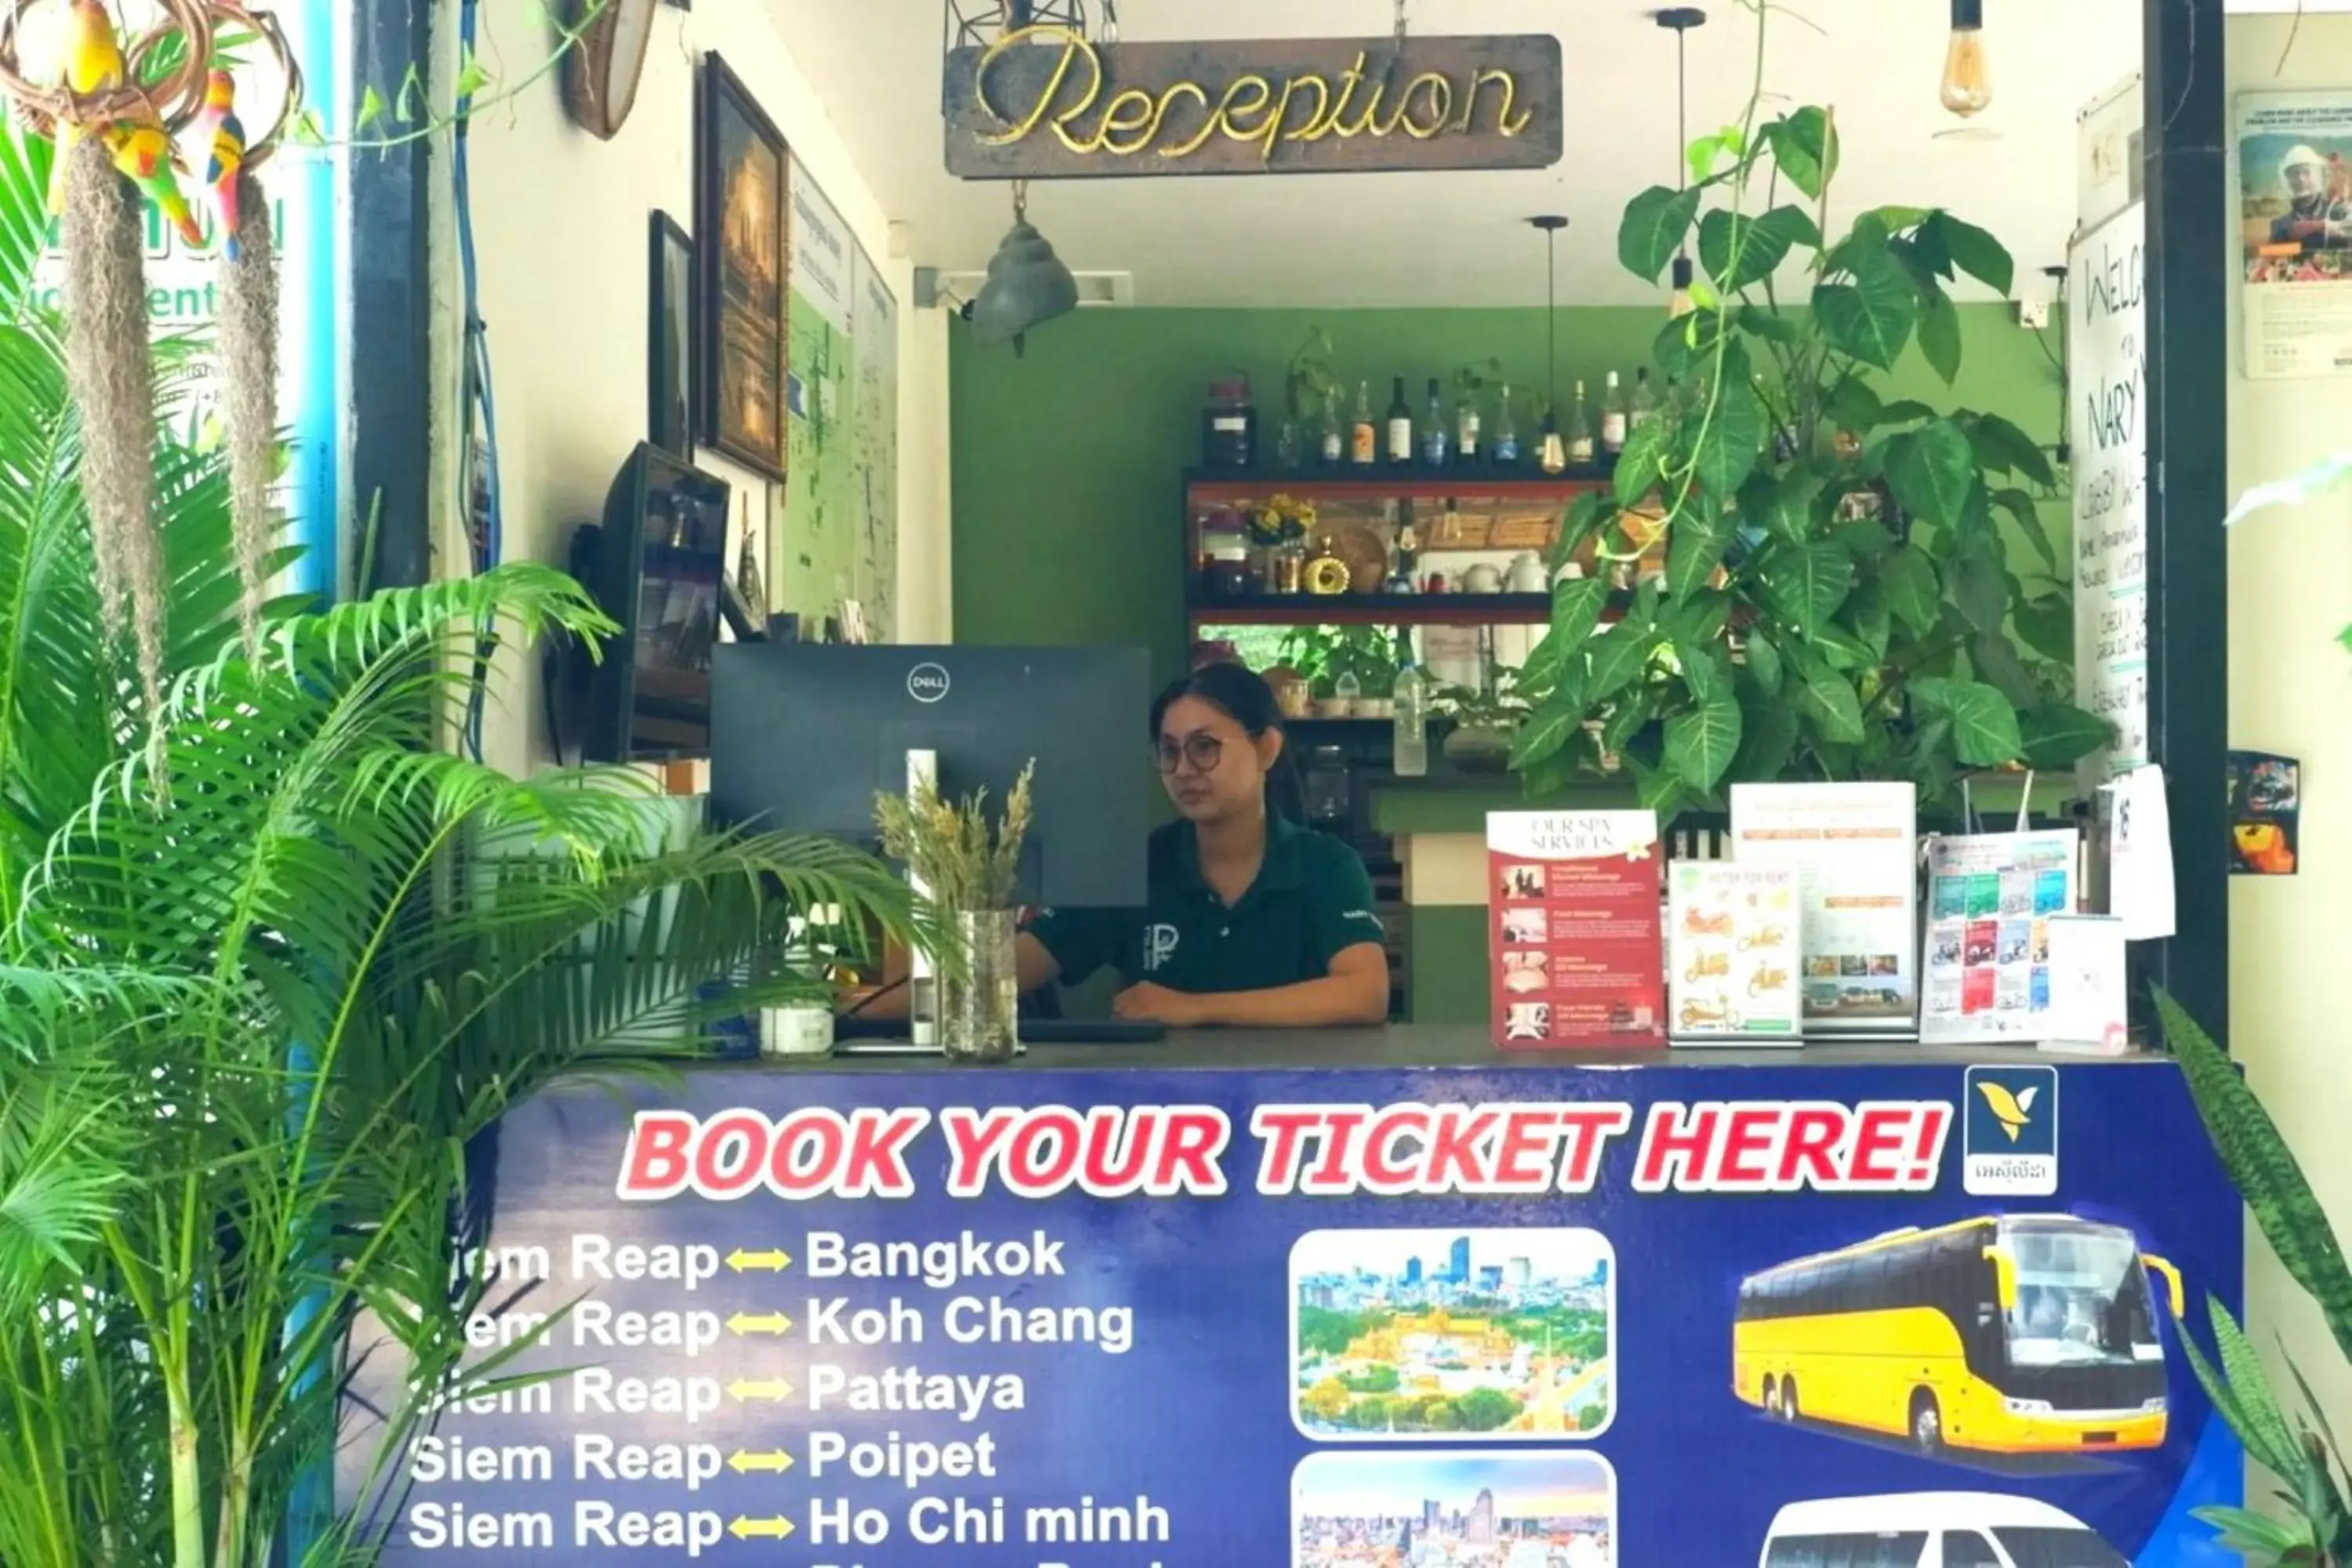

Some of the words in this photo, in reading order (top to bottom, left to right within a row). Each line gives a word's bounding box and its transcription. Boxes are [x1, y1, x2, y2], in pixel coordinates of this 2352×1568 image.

[975, 26, 1532, 158] Reception
[2085, 242, 2144, 327] WELC
[2088, 367, 2138, 452] NARY
[913, 676, 945, 688] DELL
[615, 1107, 931, 1200] BOOK
[940, 1105, 1231, 1199] YOUR
[1250, 1102, 1632, 1195] TICKET
[1632, 1101, 1953, 1191] HERE!
[449, 1236, 549, 1294] iem
[571, 1233, 719, 1290] Reap
[807, 1230, 1065, 1288] Bangkok
[464, 1312, 551, 1347] em
[572, 1300, 720, 1356] Reap
[808, 1297, 924, 1344] Koh
[944, 1296, 1134, 1353] Chang
[573, 1367, 721, 1424] Reap
[809, 1364, 1025, 1421] Pattaya
[410, 1436, 552, 1482] Siem
[574, 1433, 722, 1490] Reap
[808, 1431, 996, 1489] Poipet
[409, 1502, 553, 1548] Siem
[575, 1501, 722, 1557] Reap
[810, 1497, 889, 1544] Ho
[908, 1496, 1005, 1544] Chi
[1025, 1495, 1170, 1542] minh
